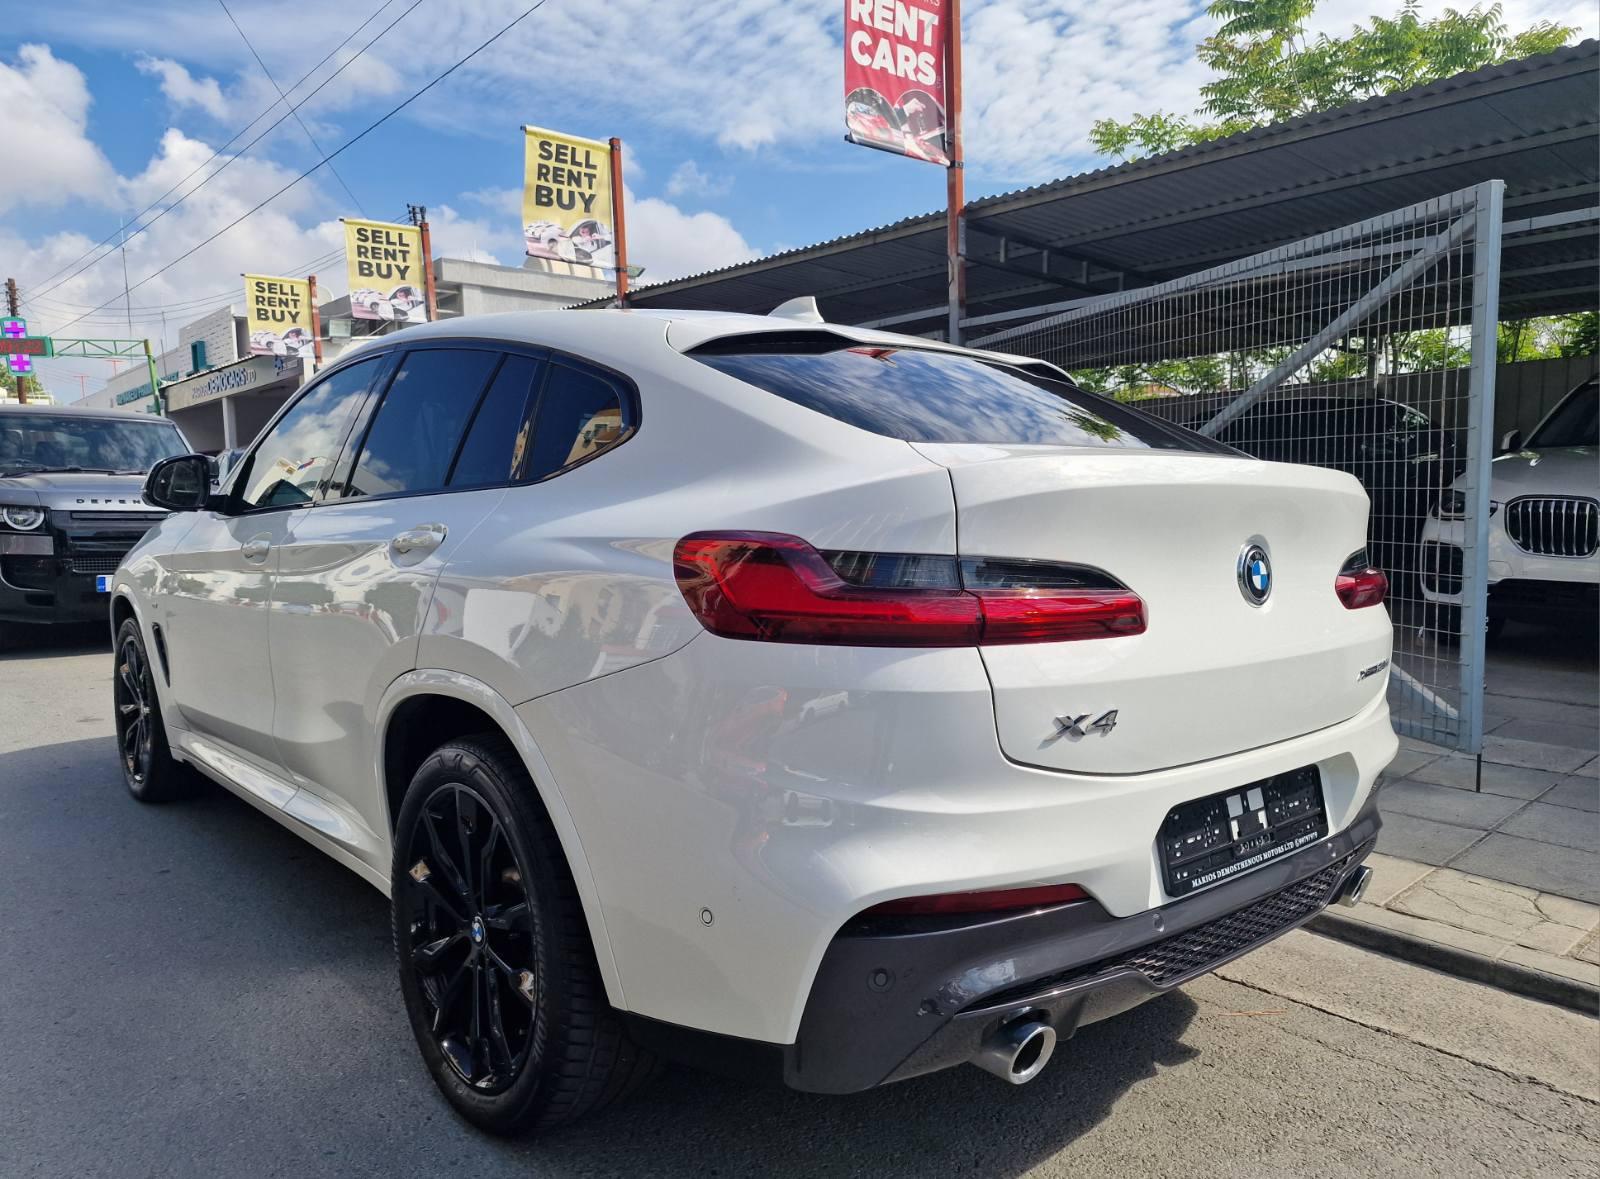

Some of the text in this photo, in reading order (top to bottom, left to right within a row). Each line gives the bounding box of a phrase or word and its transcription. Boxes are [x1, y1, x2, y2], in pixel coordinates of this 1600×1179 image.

[850, 0, 939, 47] RENT
[850, 30, 937, 86] CARS
[538, 140, 598, 170] SELL
[537, 163, 597, 190] RENT
[535, 185, 597, 213] BUY
[356, 227, 410, 247] SELL
[356, 244, 410, 263] RENT
[357, 260, 410, 280] BUY
[255, 281, 300, 297] SELL
[255, 295, 301, 309] RENT
[256, 307, 301, 324] BUY
[1053, 709, 1119, 737] X4
[1192, 841, 1295, 888] MARIOS DEMOSTHENOUS MOTORS LTD
